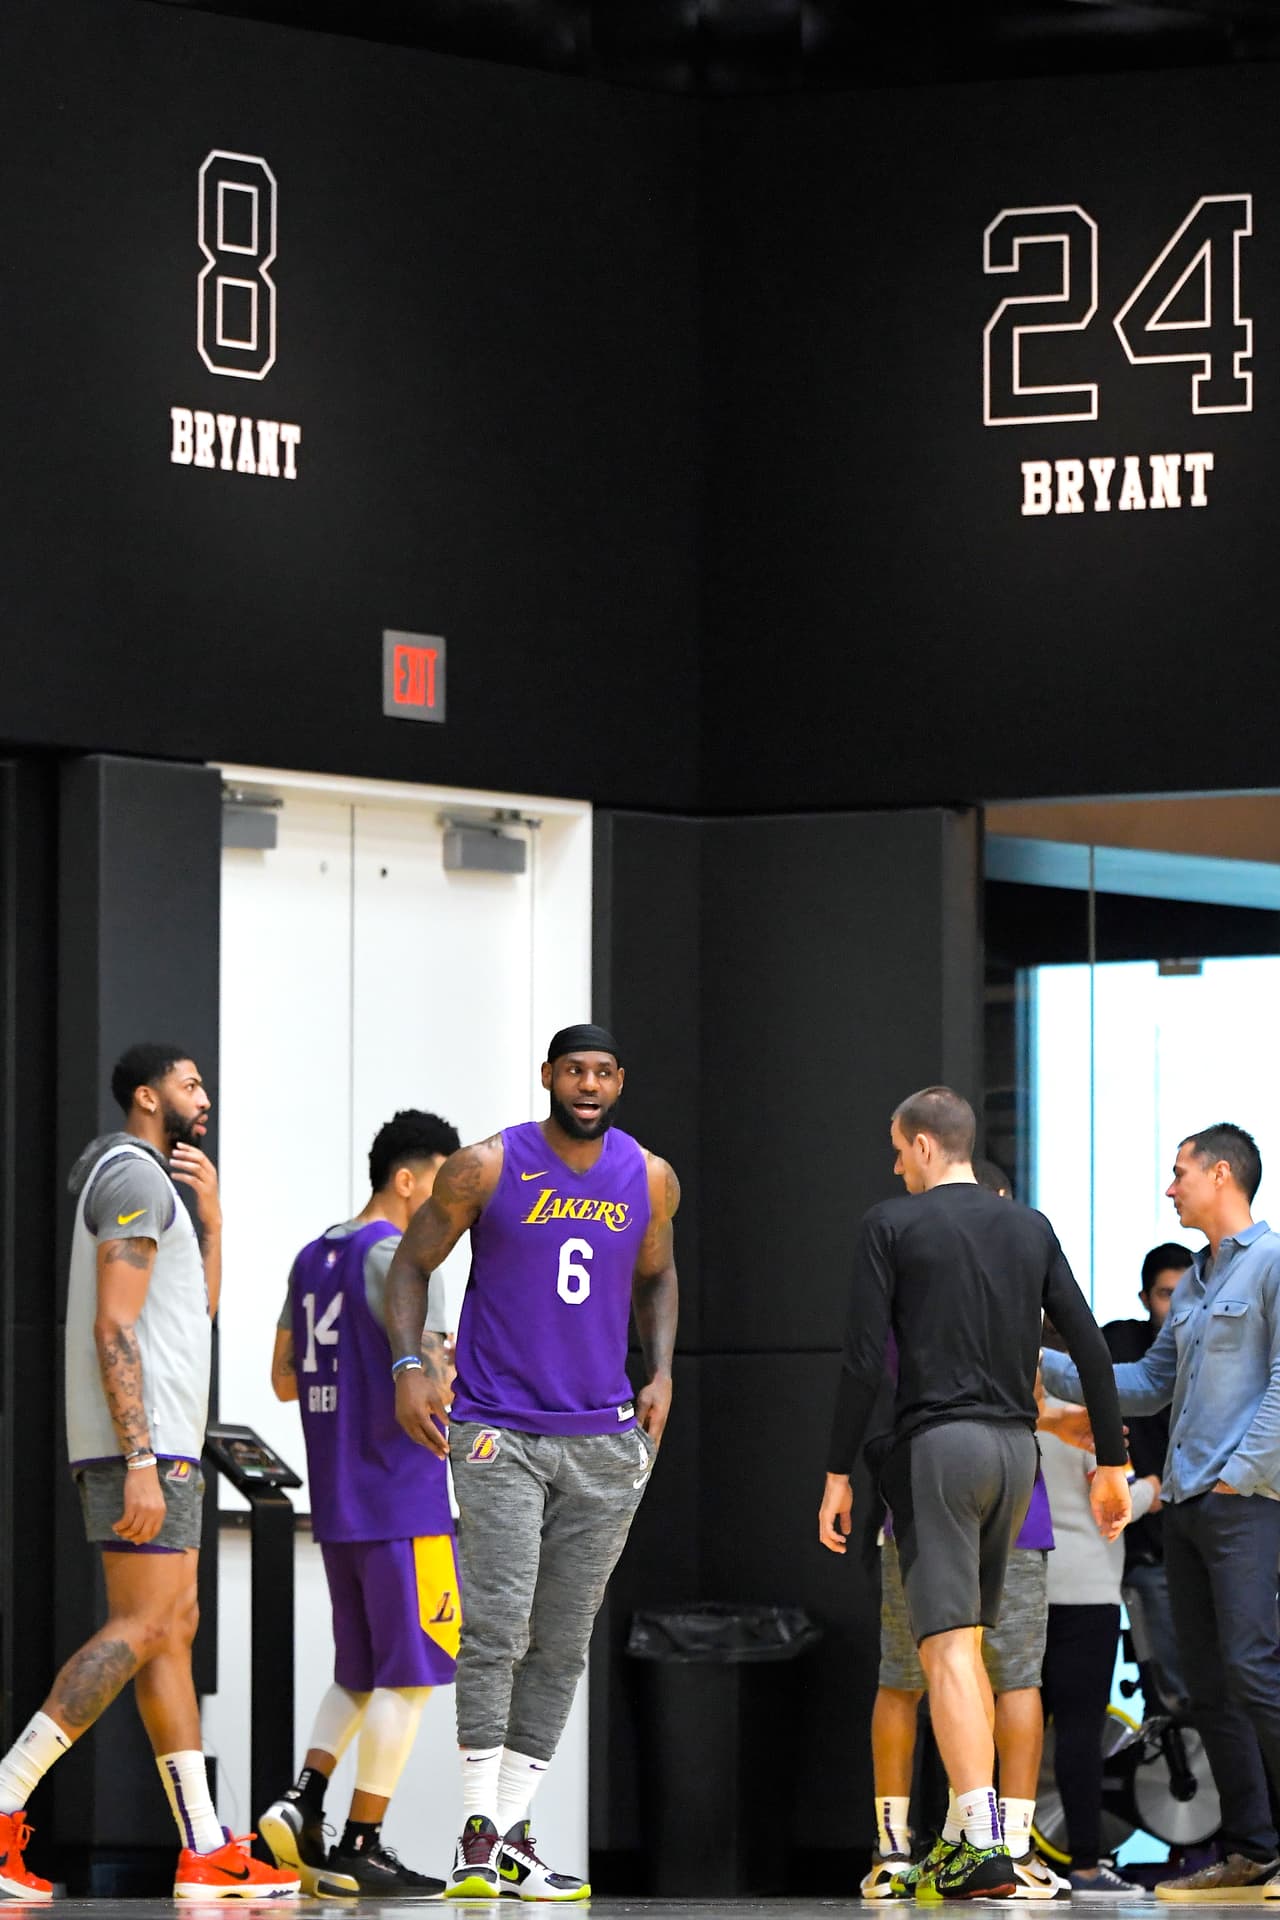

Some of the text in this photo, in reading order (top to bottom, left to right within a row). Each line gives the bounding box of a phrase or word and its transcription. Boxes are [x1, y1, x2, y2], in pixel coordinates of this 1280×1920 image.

[196, 149, 279, 381] 8
[982, 193, 1254, 428] 24
[169, 406, 302, 481] BRYANT
[1020, 451, 1215, 517] BRYANT
[394, 645, 437, 706] EXIT
[522, 1188, 631, 1232] LAKERS
[556, 1238, 594, 1305] 6
